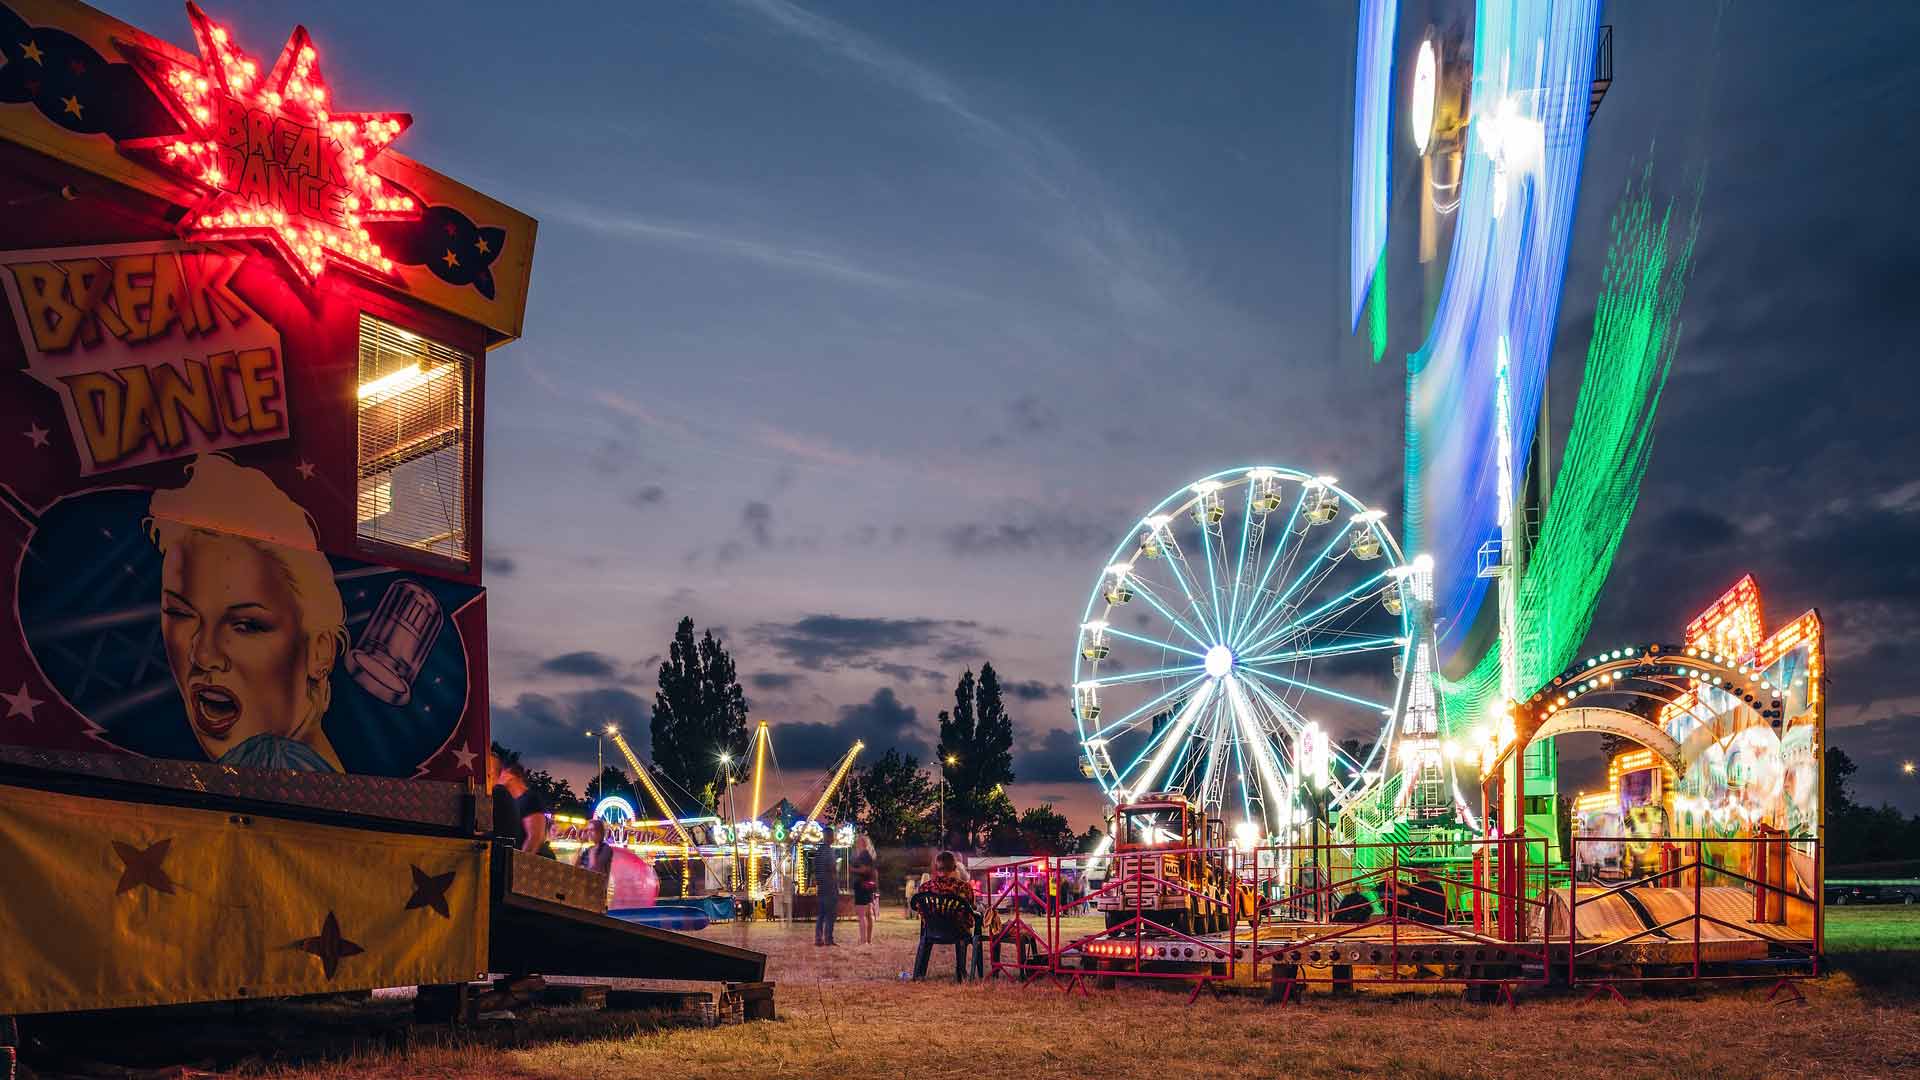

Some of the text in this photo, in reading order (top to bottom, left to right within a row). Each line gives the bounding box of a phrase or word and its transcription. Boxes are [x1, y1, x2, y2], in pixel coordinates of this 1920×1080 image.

[217, 149, 352, 231] DANCE
[219, 97, 348, 188] BREAK
[9, 251, 247, 352] BREAK
[57, 348, 281, 464] DANCE
